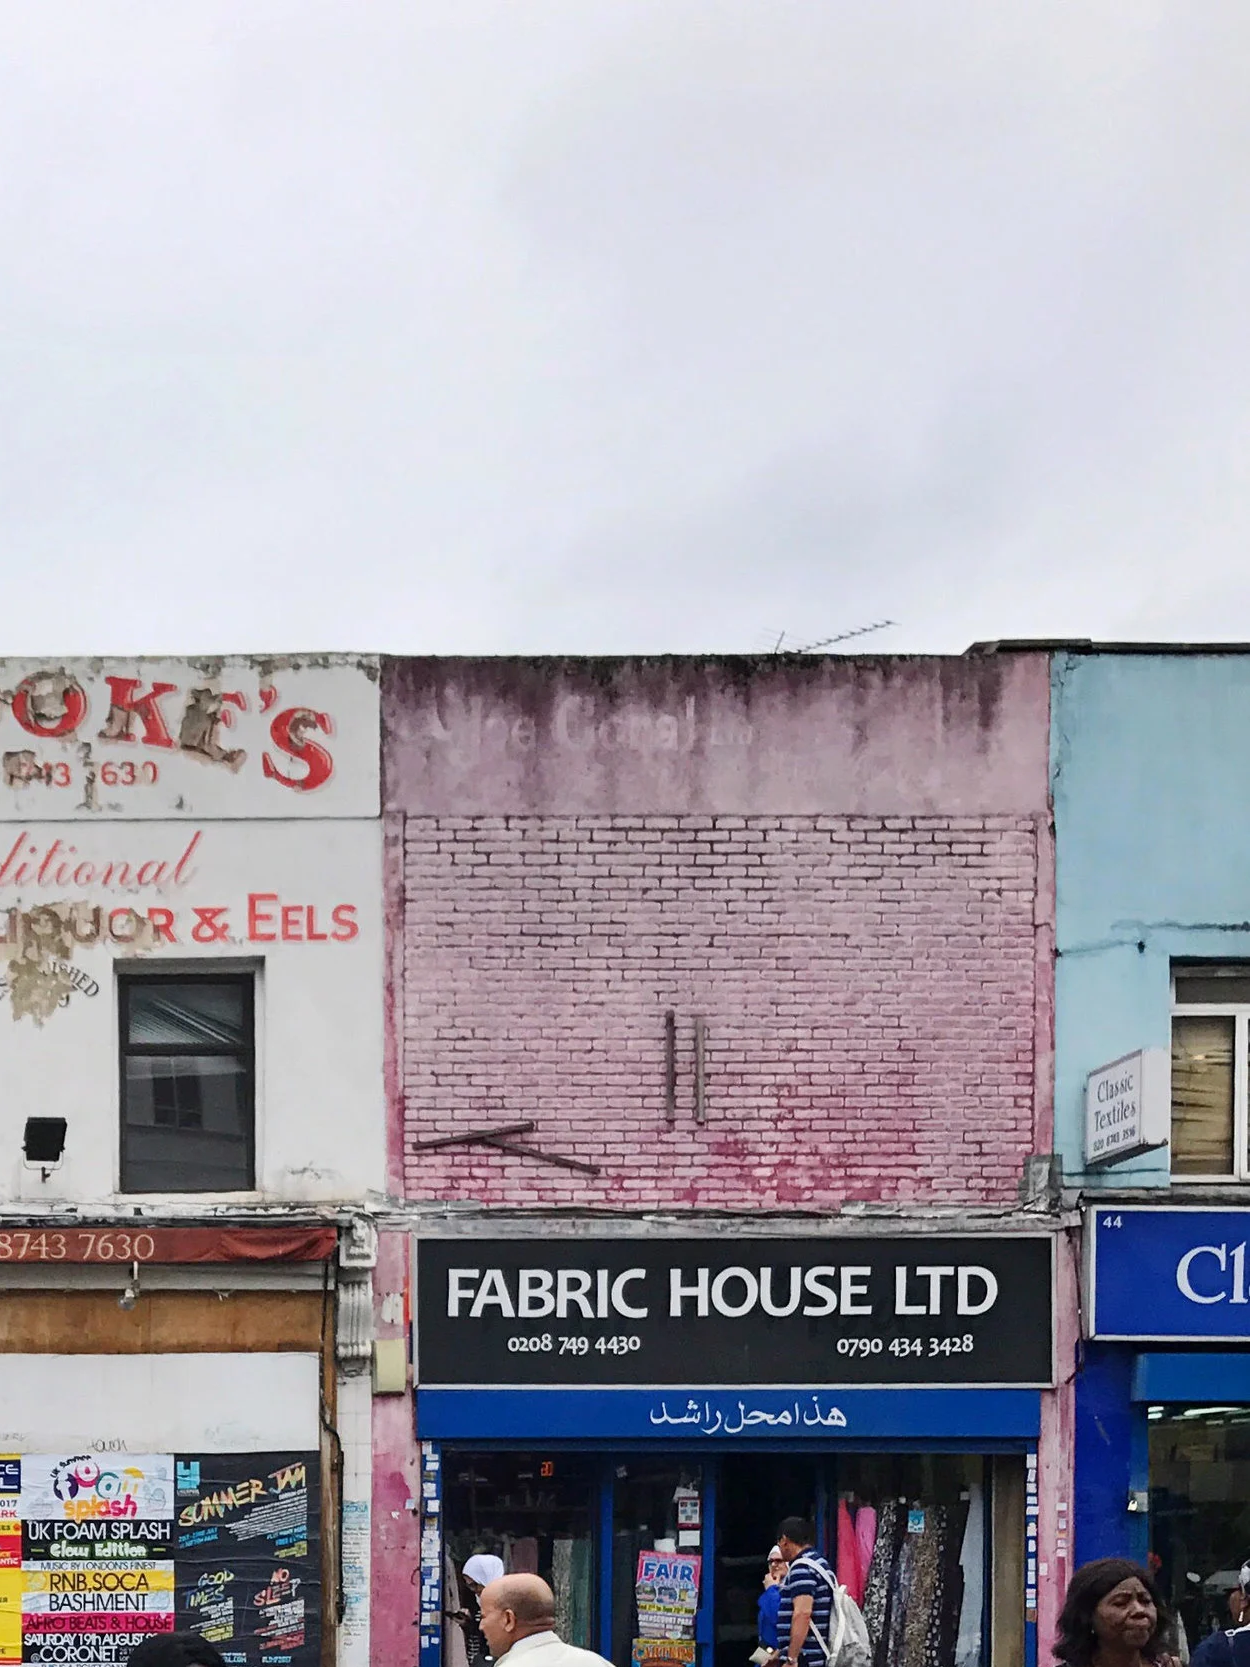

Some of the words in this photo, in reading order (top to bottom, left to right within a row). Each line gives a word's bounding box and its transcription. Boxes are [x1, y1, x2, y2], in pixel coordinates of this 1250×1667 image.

[190, 907, 230, 943] &
[247, 892, 360, 943] EELS
[1097, 1070, 1134, 1103] Classic
[1094, 1100, 1137, 1133] Textiles
[1102, 1215, 1123, 1228] 44
[78, 1233, 154, 1260] 7630
[1176, 1241, 1250, 1304] Cl
[447, 1268, 648, 1318] FABRIC
[669, 1266, 872, 1318] HOUSE
[893, 1264, 998, 1316] LTD
[507, 1334, 552, 1352] 0208
[557, 1335, 590, 1356] 749
[594, 1335, 640, 1355] 4430
[836, 1338, 884, 1357] 0790
[887, 1339, 924, 1358] 434
[928, 1335, 974, 1357] 3428
[178, 1479, 268, 1527] SUMMER
[267, 1461, 306, 1494] JAM
[63, 1494, 138, 1523] splash
[29, 1522, 50, 1540] UK
[54, 1522, 106, 1540] FOAM
[110, 1522, 170, 1540] SPLASH
[50, 1541, 90, 1558] Glow
[94, 1541, 147, 1557] Edition
[41, 1562, 67, 1570] MUSIC
[70, 1562, 81, 1570] BY
[83, 1562, 128, 1570] LONDON'S
[130, 1562, 156, 1570] FINEST
[643, 1563, 693, 1581] FAIR
[197, 1568, 235, 1587] GOOD
[50, 1593, 148, 1612] BASHMENT
[26, 1615, 66, 1630] AFRO
[69, 1615, 107, 1630] BEATS
[111, 1616, 122, 1630] &
[125, 1616, 171, 1630] HOUSE
[24, 1633, 78, 1646] SATURDAY
[102, 1633, 145, 1646] AUGUST
